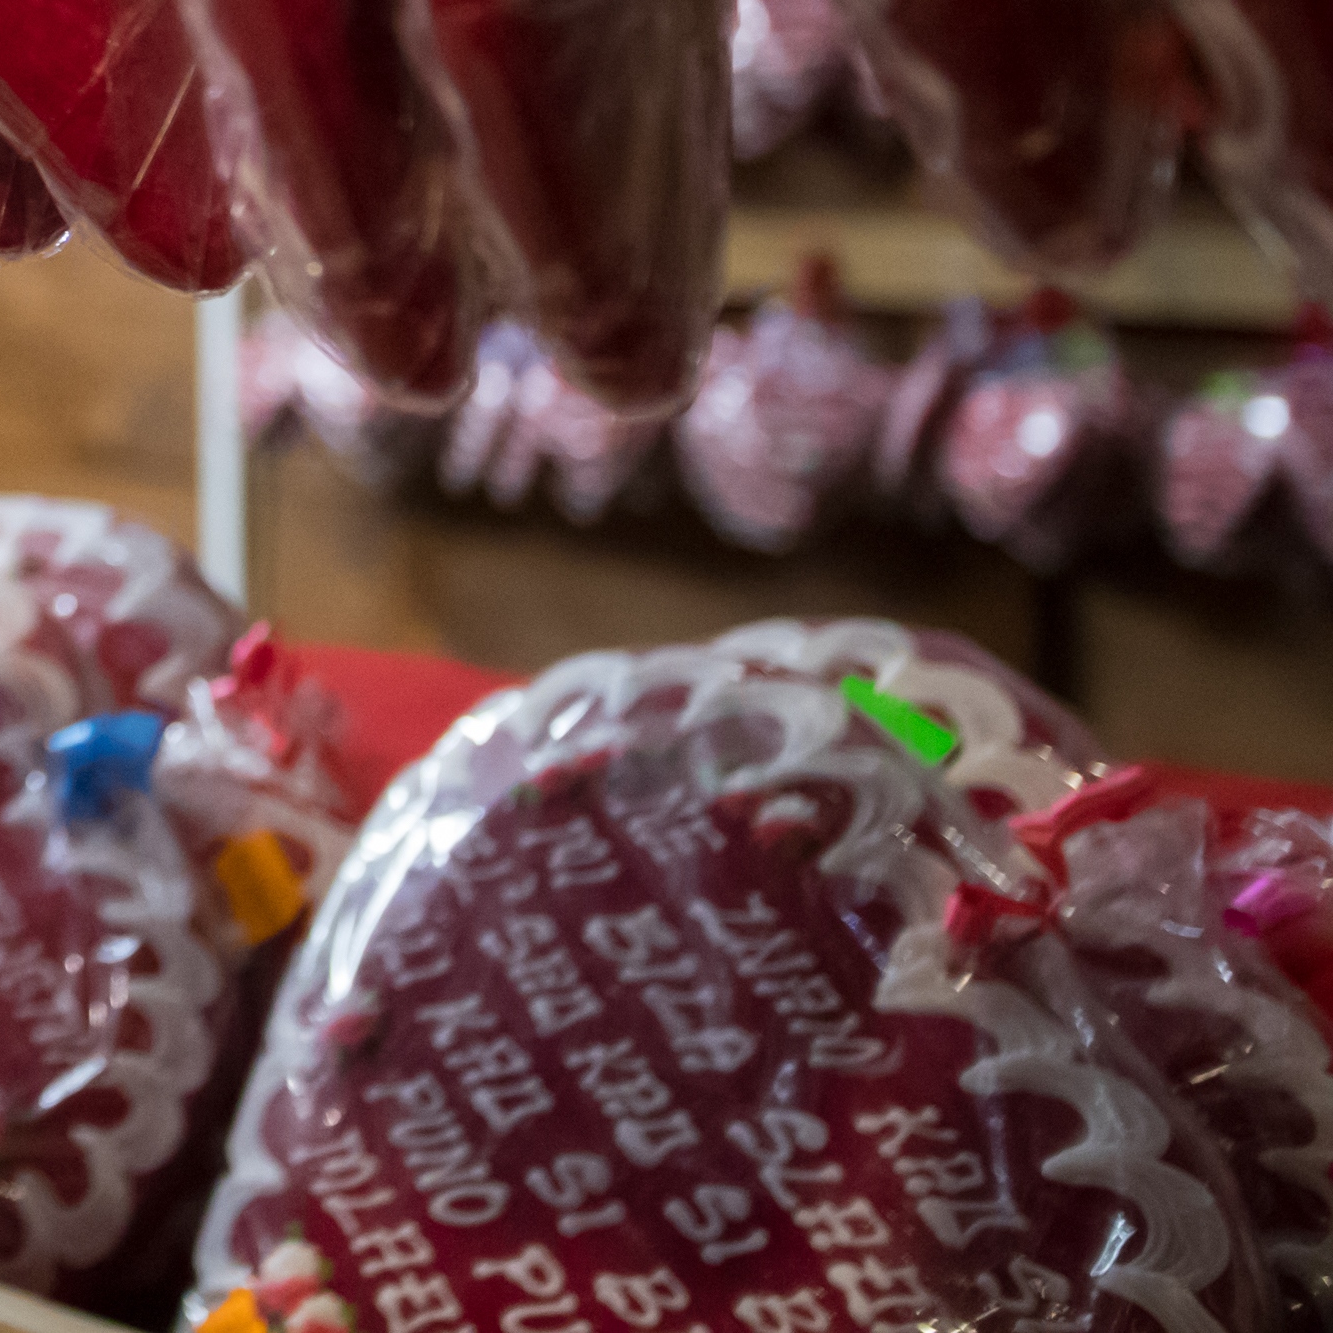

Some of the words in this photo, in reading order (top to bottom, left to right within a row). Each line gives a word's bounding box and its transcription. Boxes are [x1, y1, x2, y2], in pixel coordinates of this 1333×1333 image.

[362, 1069, 513, 1229] PUNO
[412, 991, 555, 1135] KAD
[524, 1150, 627, 1238] SI
[561, 1035, 700, 1167] KAD
[662, 1181, 770, 1266] SI
[581, 902, 763, 1073] BILA
[726, 1107, 938, 1333] SLAĐ
[851, 1101, 1030, 1250] KAD
[284, 1123, 477, 1333] MLAĐ
